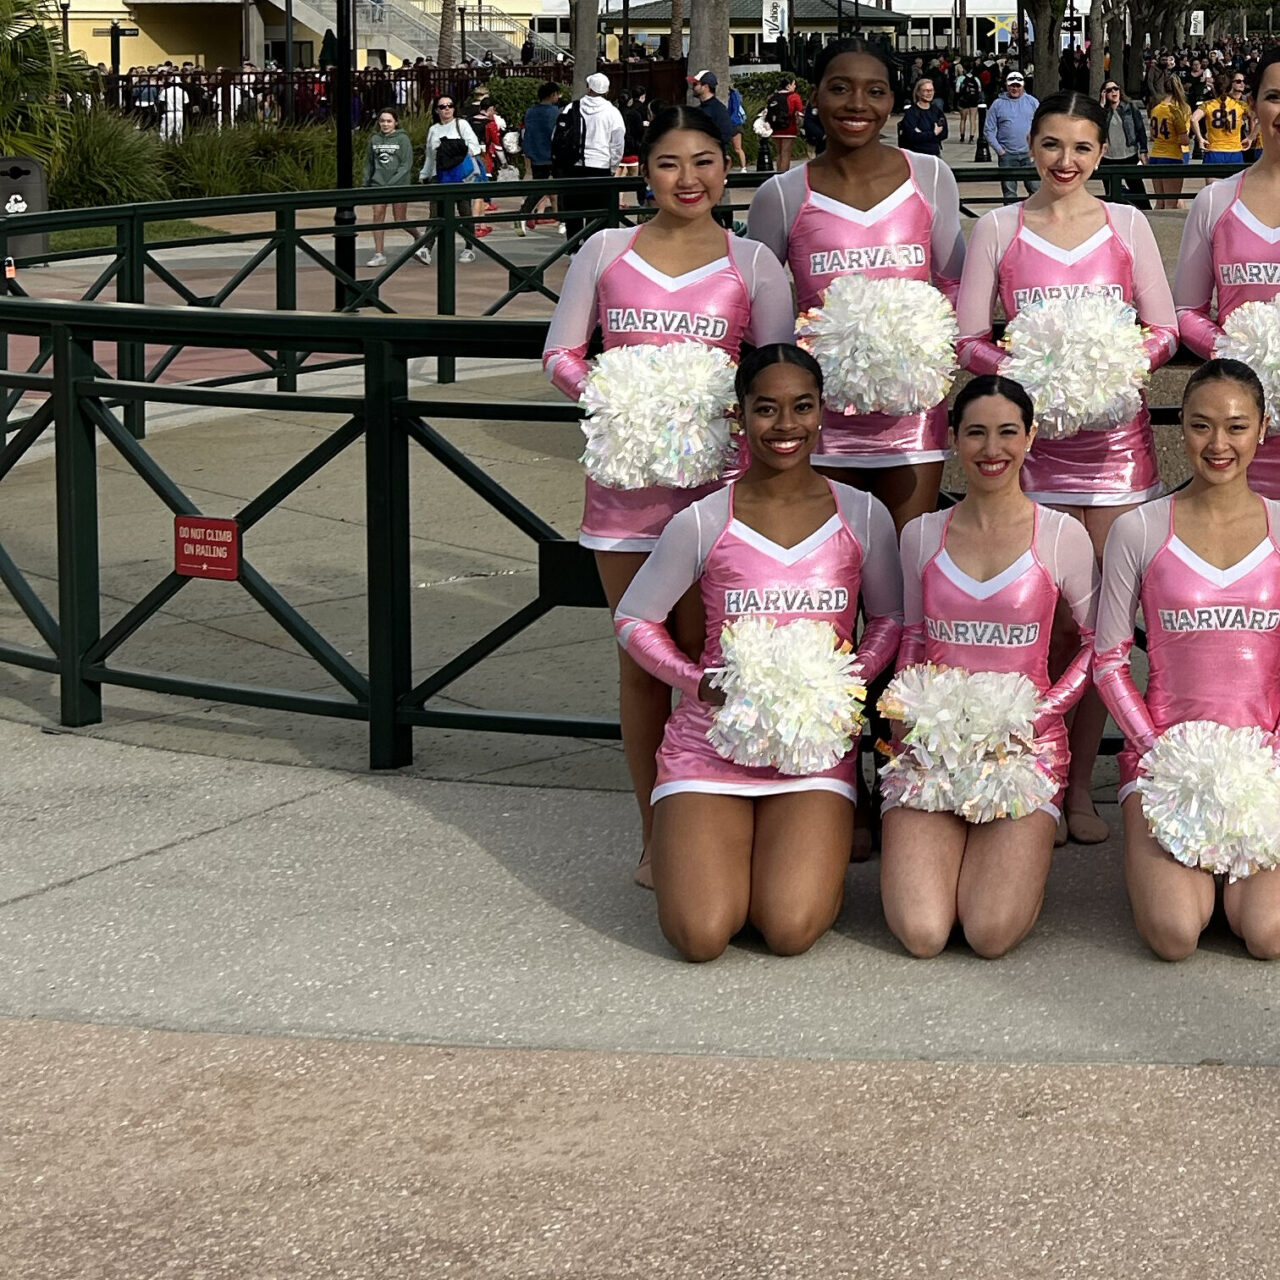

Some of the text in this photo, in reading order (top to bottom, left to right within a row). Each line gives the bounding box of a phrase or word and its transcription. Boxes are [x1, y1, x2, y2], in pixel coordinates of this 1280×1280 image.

[1212, 108, 1237, 131] 81
[810, 245, 926, 276] HARVARD
[607, 308, 728, 341] HARVARD
[179, 526, 232, 542] DO NOT CLIMB
[184, 543, 227, 558] ON RAILING
[725, 587, 848, 615] HARVARD
[924, 618, 1040, 647] HARVARD
[1158, 606, 1280, 633] HARVARD
